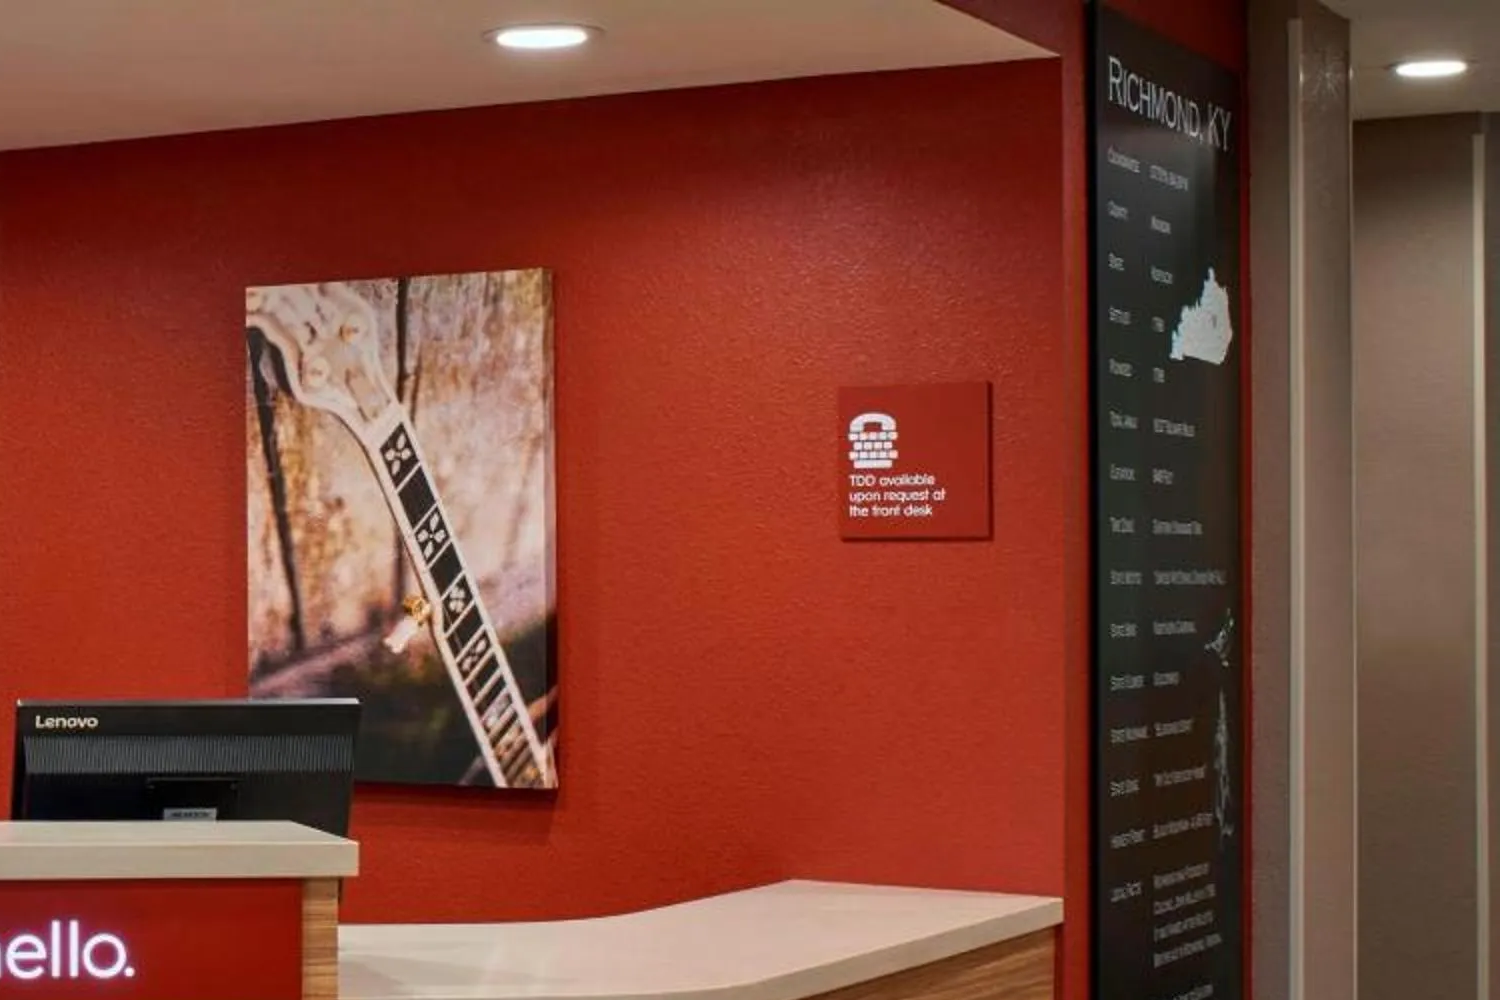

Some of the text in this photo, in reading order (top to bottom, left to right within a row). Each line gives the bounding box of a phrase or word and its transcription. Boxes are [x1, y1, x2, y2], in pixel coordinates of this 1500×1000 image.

[1108, 55, 1231, 151] RICHMOND, KY
[849, 474, 936, 487] TDD available
[849, 487, 946, 506] upon request at
[849, 503, 933, 517] the front desk
[35, 714, 99, 729] Lenovo
